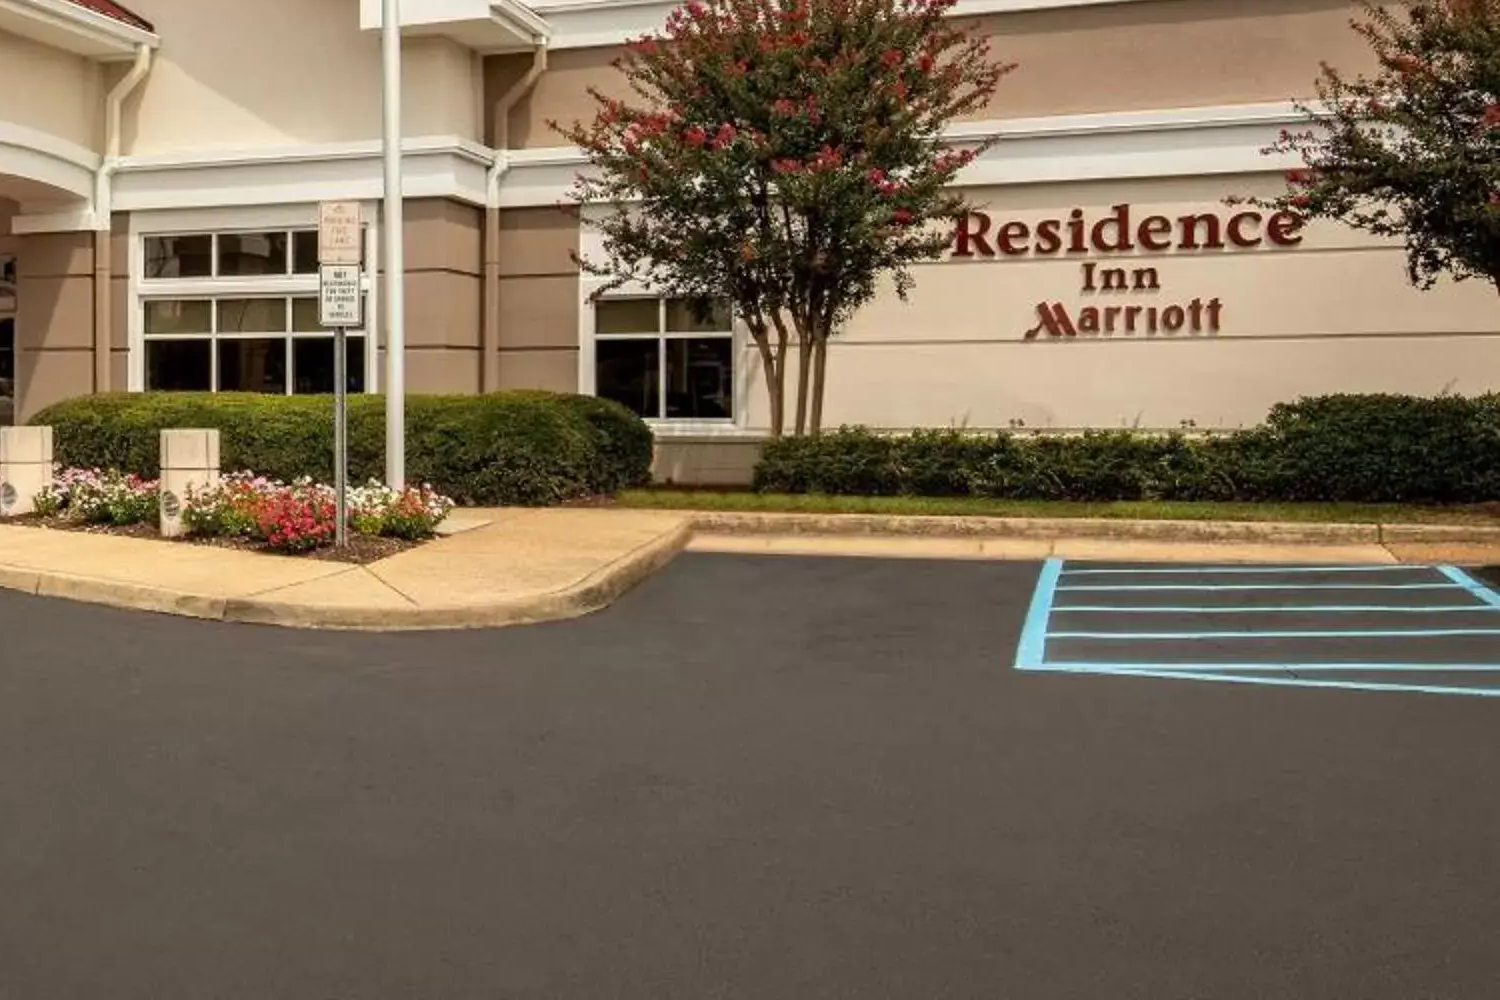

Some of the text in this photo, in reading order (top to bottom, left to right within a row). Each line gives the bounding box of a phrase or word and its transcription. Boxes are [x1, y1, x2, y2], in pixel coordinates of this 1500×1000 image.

[952, 204, 1302, 256] Residence
[1081, 262, 1161, 291] Inn
[1025, 299, 1222, 340] Marriott
